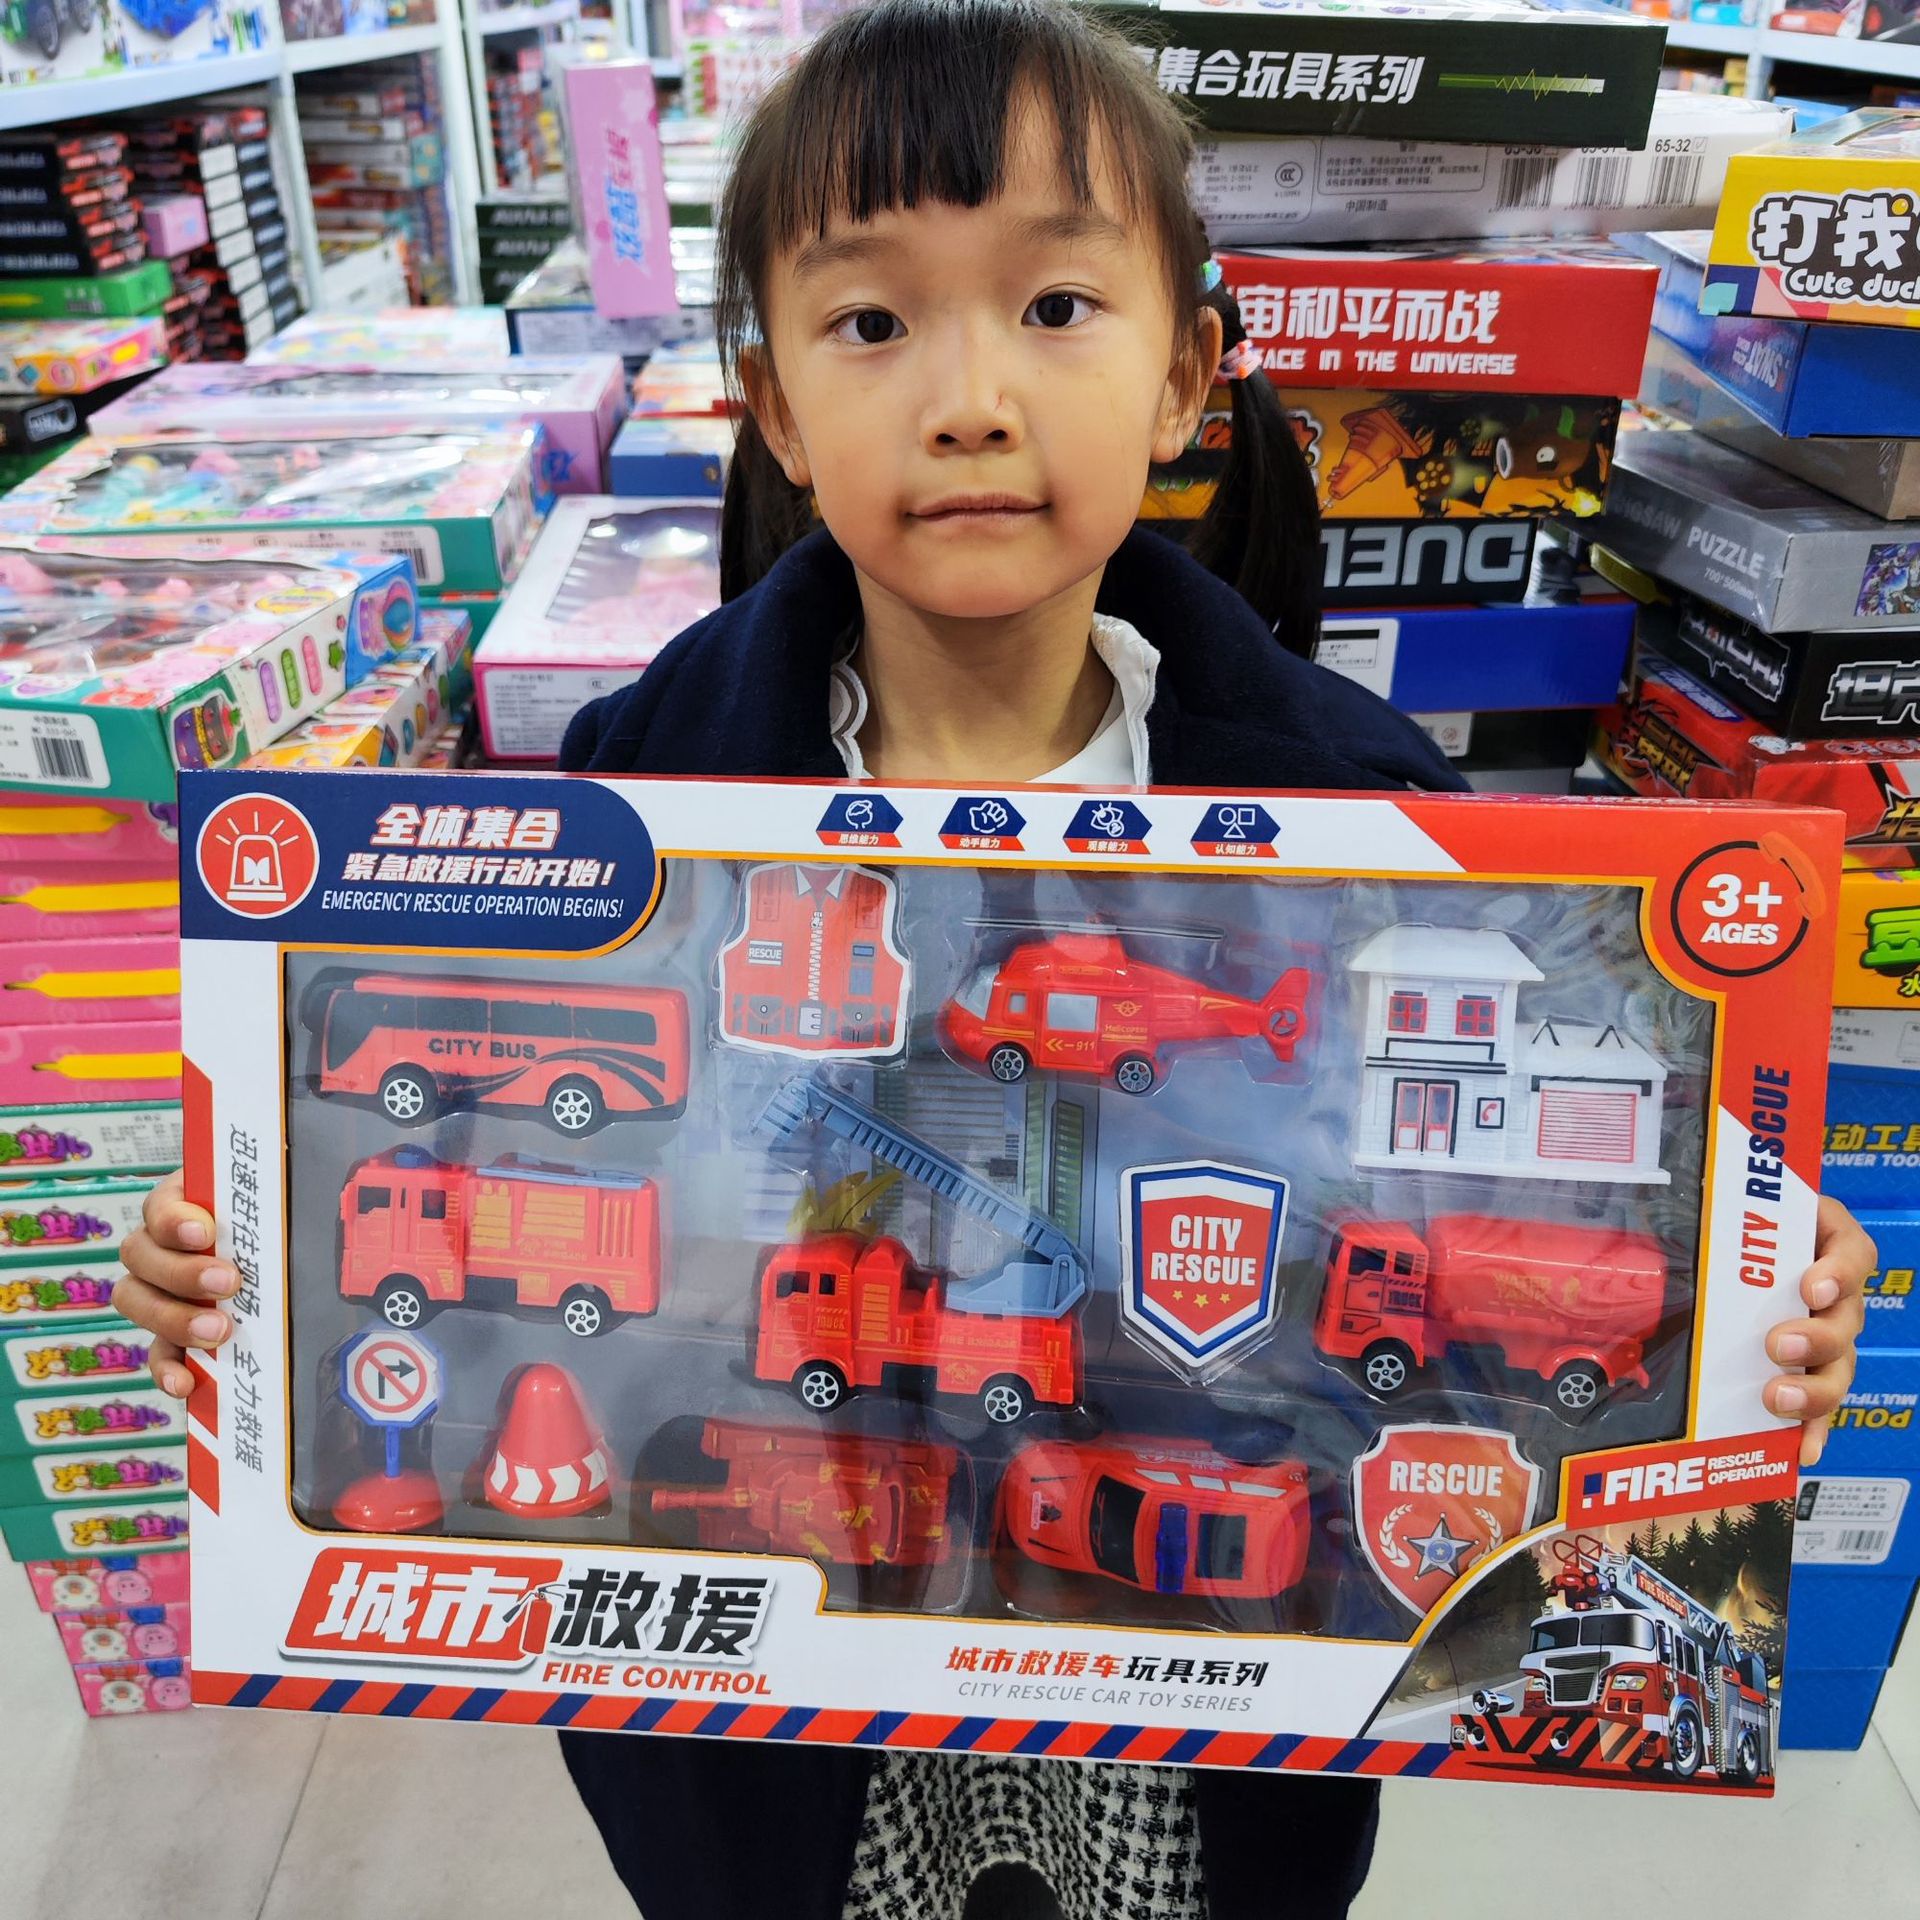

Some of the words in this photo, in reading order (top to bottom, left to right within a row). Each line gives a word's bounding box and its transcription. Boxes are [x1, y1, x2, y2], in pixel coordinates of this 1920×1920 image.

[1655, 139, 1690, 153] 65-32
[1756, 197, 1920, 271] 打我
[1789, 268, 1853, 294] Cute
[1226, 284, 1501, 344] 宙和平而战
[1319, 349, 1341, 371] IN
[1355, 350, 1397, 372] THE
[1410, 352, 1517, 376] UNIVERSE
[1687, 526, 1765, 579] PUZZLE
[370, 803, 560, 850] 全体集合
[838, 833, 880, 846] 思维能力
[960, 837, 1001, 850] 动手能力
[1087, 840, 1128, 853] 观察能力
[1215, 843, 1257, 857] 认知能力
[321, 890, 411, 912] EMERGENCY
[413, 893, 471, 914] RESCUE
[474, 895, 561, 917] OPERATION
[563, 898, 624, 918] BEGINS!
[1701, 874, 1782, 918] 3+
[1700, 922, 1780, 946] AGES
[748, 948, 782, 960] RESCUE
[429, 1038, 481, 1057] CITY
[491, 1041, 537, 1060] BUS
[1076, 1041, 1095, 1052] 911
[1746, 1065, 1790, 1202] RESCUE
[1170, 1214, 1242, 1252] CITY
[1740, 1211, 1781, 1289] CITY
[1151, 1252, 1256, 1286] RESCUE
[816, 1315, 846, 1331] TRUCK
[1707, 1450, 1765, 1470] RESCUE
[1707, 1461, 1789, 1485] OPERATION
[1390, 1460, 1504, 1497] RESCUE
[1603, 1456, 1706, 1506] FIRE
[314, 1561, 767, 1657] 城市救援
[542, 1662, 613, 1684] FIRE
[623, 1666, 772, 1694] CONTROL
[944, 1646, 1269, 1688] 城市救援车玩具系列
[958, 1682, 1001, 1697] CITY
[1008, 1684, 1085, 1702] RESCUE
[1092, 1689, 1129, 1705] CAR
[1138, 1692, 1176, 1708] TOY
[1181, 1695, 1252, 1712] SERIES
